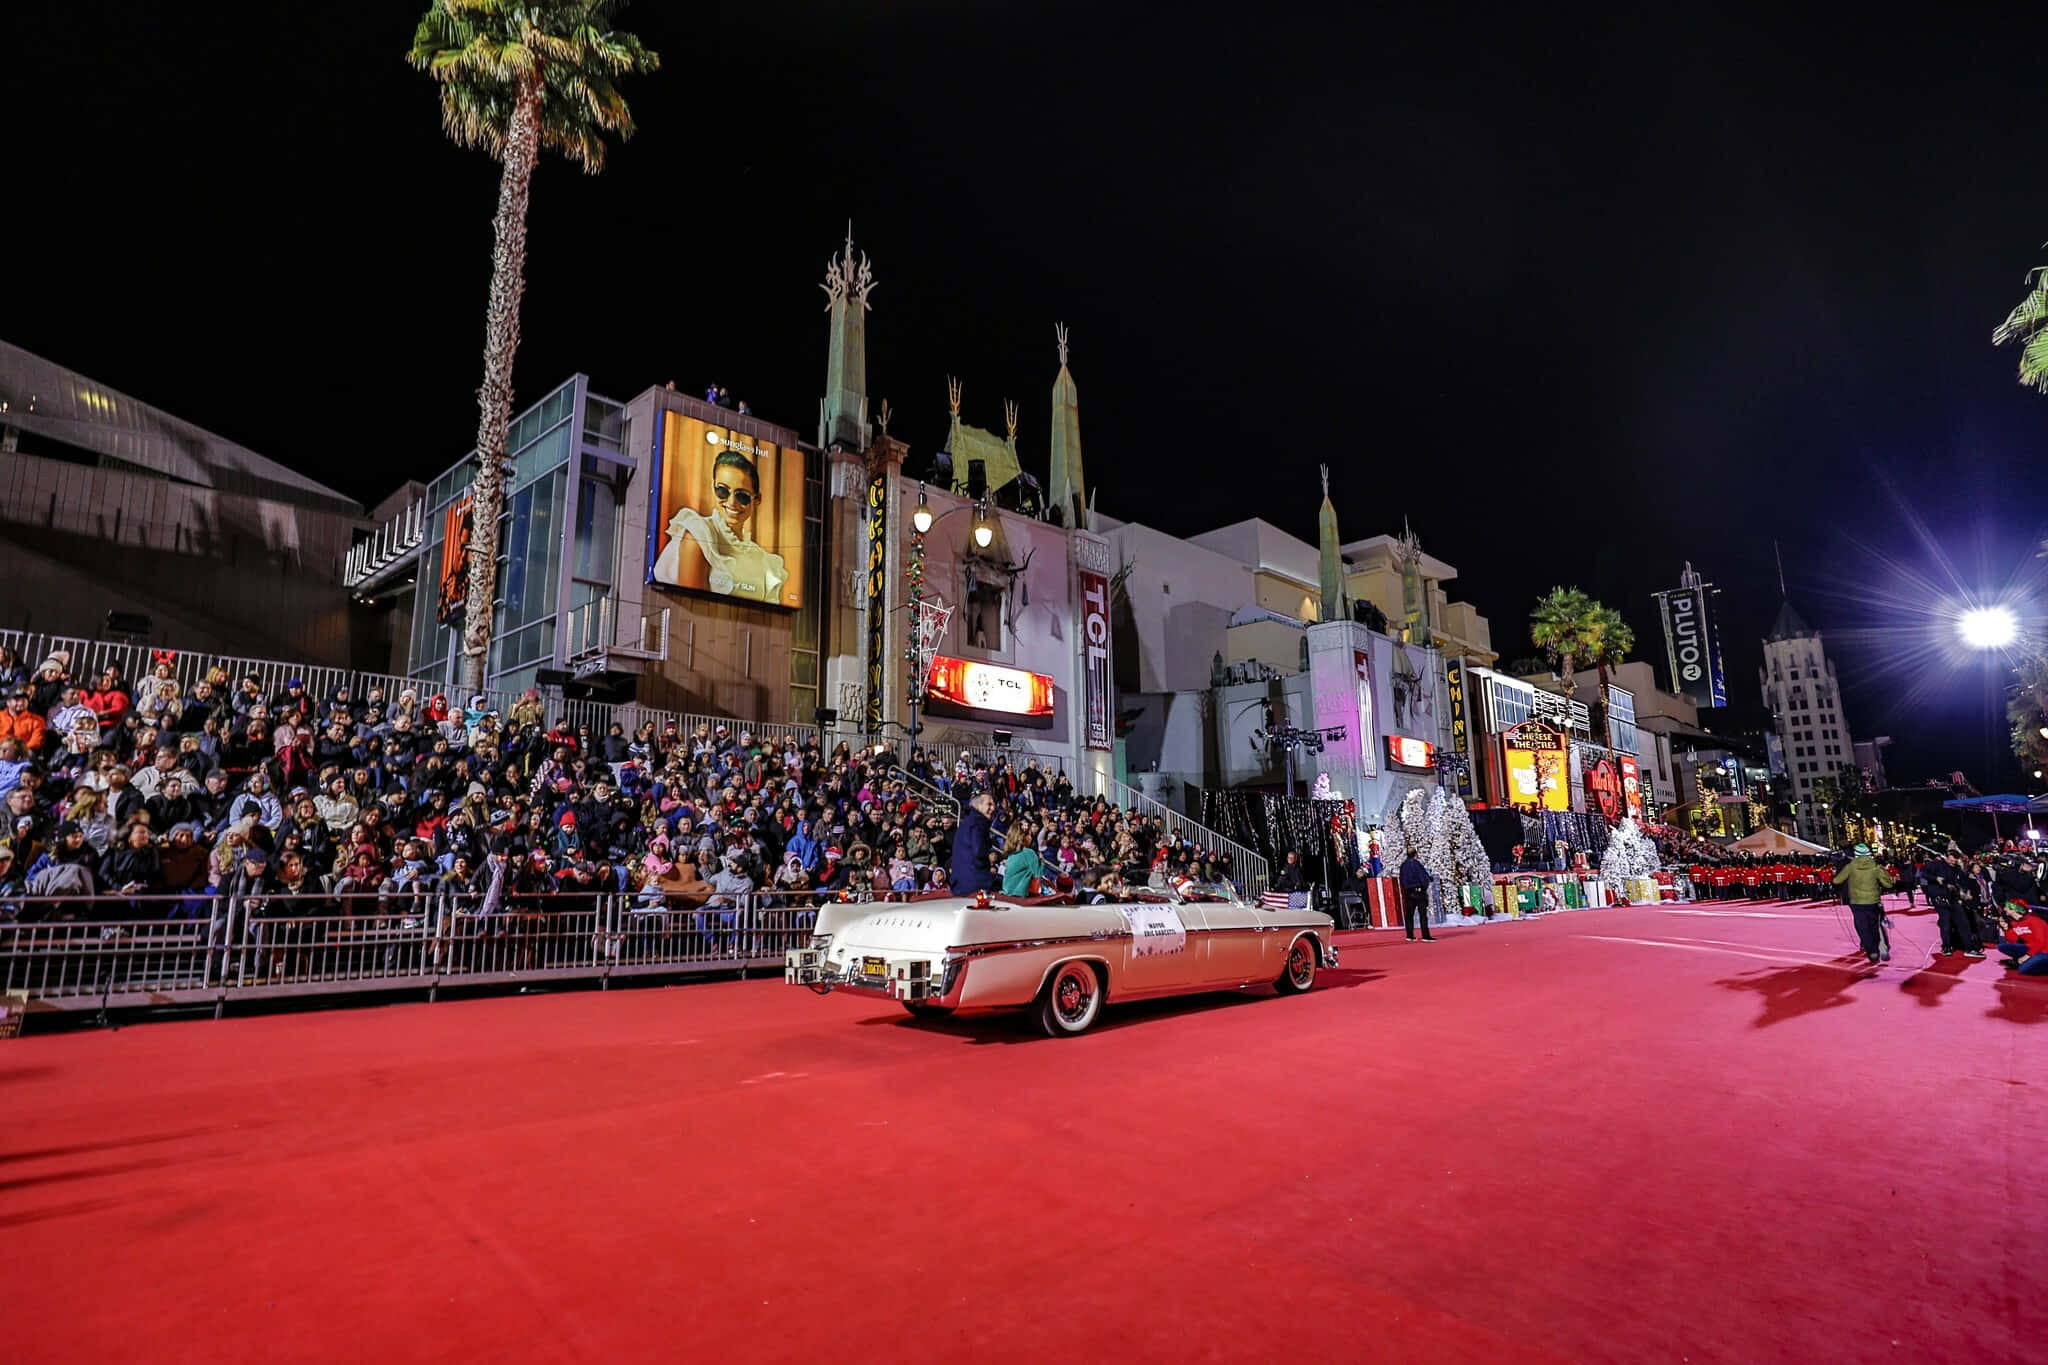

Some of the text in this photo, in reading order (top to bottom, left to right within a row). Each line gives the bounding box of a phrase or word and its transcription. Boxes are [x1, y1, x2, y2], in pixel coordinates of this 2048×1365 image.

[1086, 583, 1107, 671] TCL
[1673, 598, 1700, 664] PLUTO
[1686, 666, 1697, 679] TV
[998, 678, 1021, 689] TCL
[1525, 724, 1543, 732] TL
